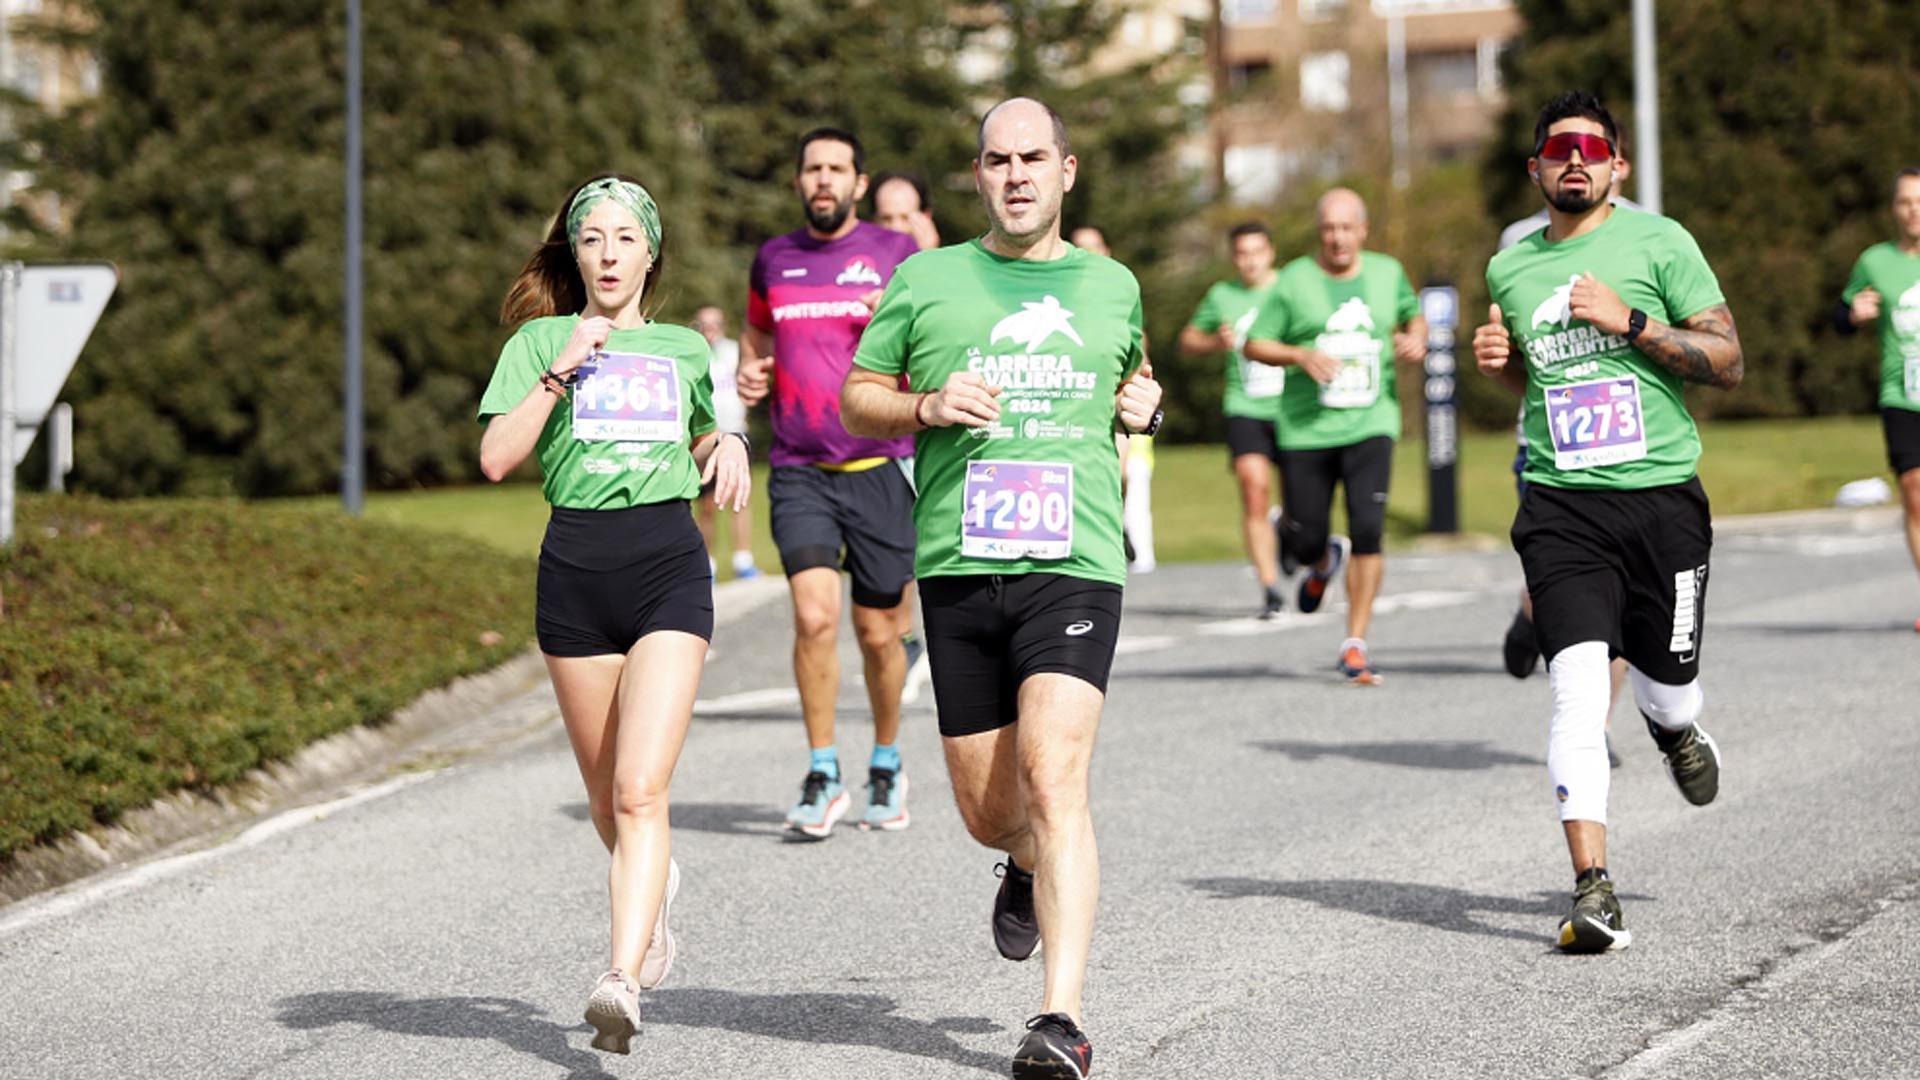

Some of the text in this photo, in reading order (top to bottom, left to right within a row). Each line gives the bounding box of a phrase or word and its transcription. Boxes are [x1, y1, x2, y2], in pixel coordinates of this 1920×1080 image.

[784, 302, 869, 319] INTERSPO
[1526, 325, 1601, 355] CARRERA
[1539, 335, 1629, 365] VALIENTES
[968, 355, 1073, 373] CARRERA
[1564, 361, 1600, 378] 2024
[582, 374, 670, 412] 1361
[984, 371, 1097, 389] VALIENTES
[1009, 399, 1051, 413] 2024
[1556, 401, 1637, 444] 1273
[972, 489, 1067, 532] 1290
[1670, 569, 1695, 652] PUMA
